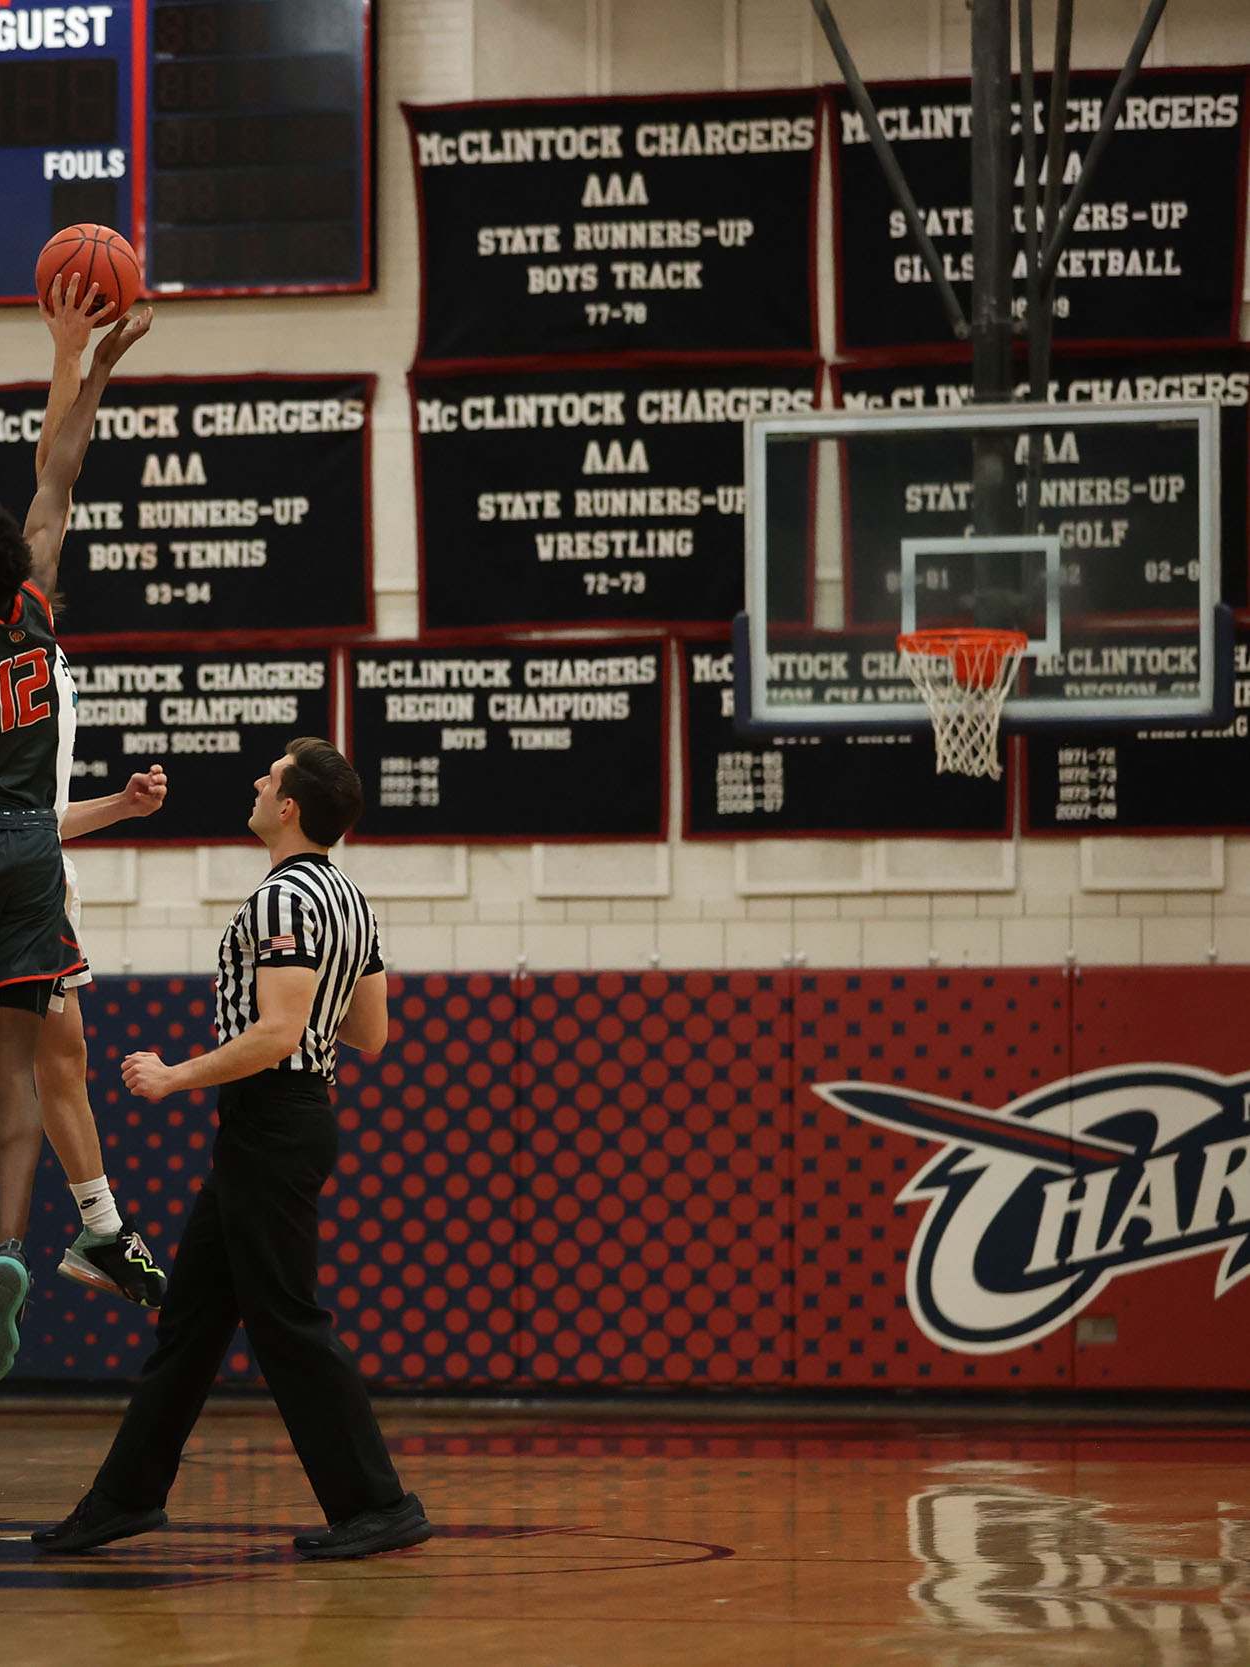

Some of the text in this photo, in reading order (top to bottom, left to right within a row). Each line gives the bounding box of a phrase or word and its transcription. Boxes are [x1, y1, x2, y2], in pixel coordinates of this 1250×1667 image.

[841, 95, 1238, 143] MCLINTK CHRGERS
[418, 118, 814, 165] McCLINTOCK CHARGERS
[44, 149, 125, 179] FOULS
[582, 173, 648, 206] AAA
[478, 220, 753, 255] STATE RUNNERS-UP
[890, 208, 973, 237] SATE
[528, 262, 702, 293] BOYS TRACK
[895, 250, 1181, 282] GILS AKETBALL
[193, 400, 364, 436] CHARGERS
[417, 388, 813, 432] McCLINTOCK CHARGERS
[143, 453, 206, 486] AAA
[583, 441, 648, 474] AAA
[479, 492, 560, 520] STATE
[906, 475, 1185, 512] STAT NNERS-UP
[67, 498, 308, 531] TATE RUNNERS-UP
[536, 530, 693, 560] WRESTLING
[1059, 521, 1128, 548] GOLF
[90, 540, 266, 570] BOYS TENNIS
[584, 572, 645, 594] 72-73
[358, 656, 655, 688] McCLINTOCK CHARGERS
[691, 652, 850, 684] McCNTOCK
[1035, 646, 1199, 677] McCLINTOCK
[71, 663, 324, 693] CLINTOCK CHARGERS
[77, 697, 297, 727] EGION CHAMPIONS
[387, 692, 629, 721] REGION CHAMPIONS
[171, 731, 240, 753] SOCCER
